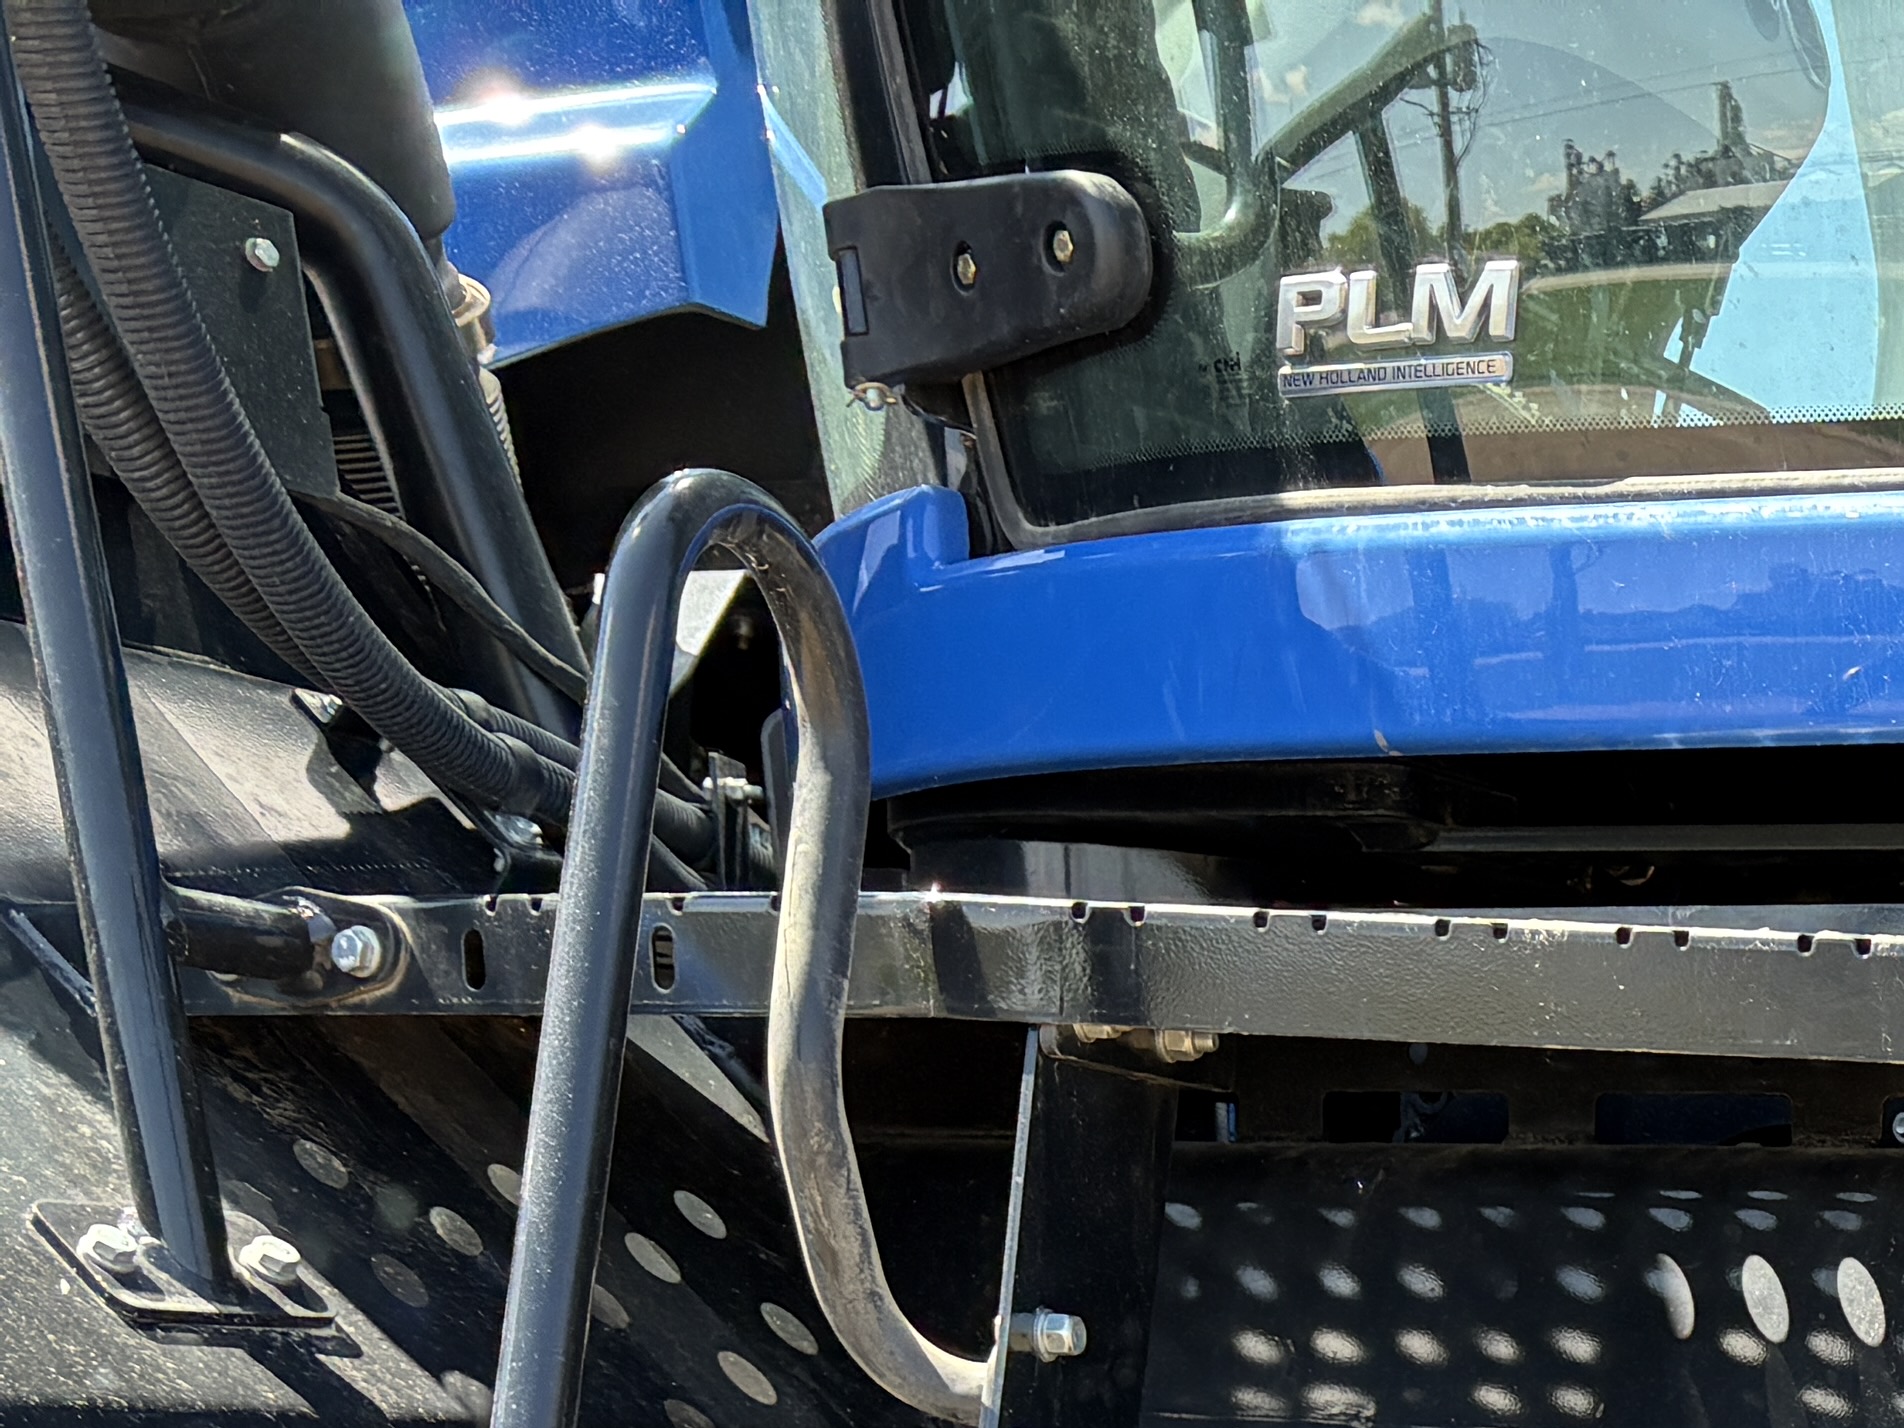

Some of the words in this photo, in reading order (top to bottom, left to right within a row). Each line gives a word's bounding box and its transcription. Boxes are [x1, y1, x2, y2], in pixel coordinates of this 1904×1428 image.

[1276, 260, 1519, 355] PLM
[1282, 372, 1315, 388] NEW
[1319, 365, 1388, 385] HOLLAND
[1391, 359, 1497, 382] INTELLIGENCE
